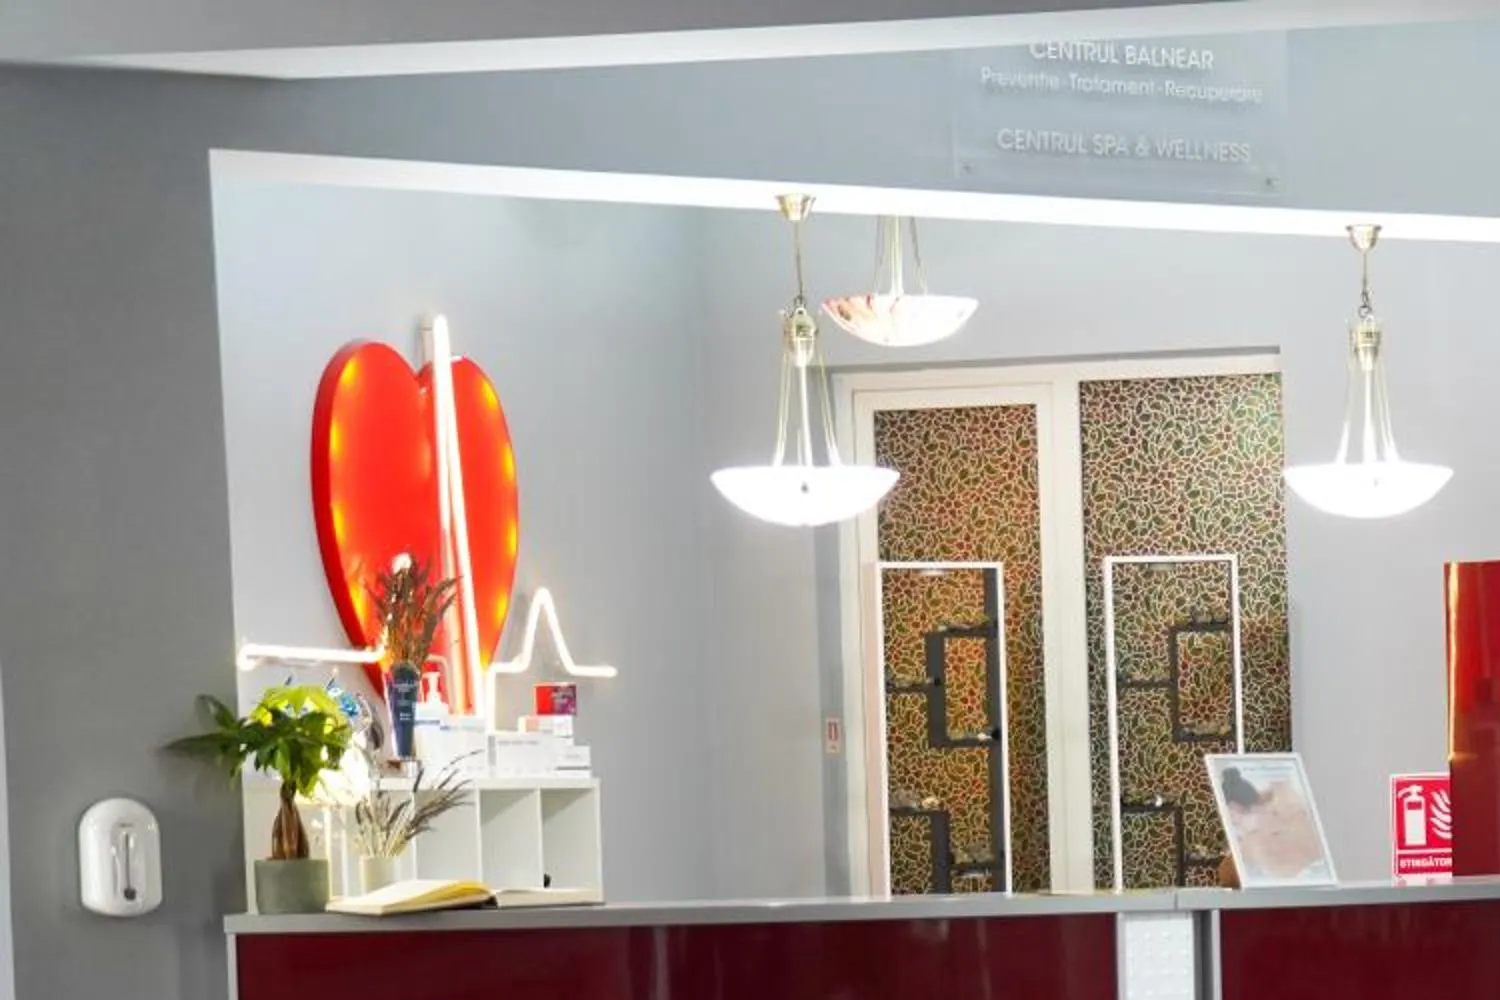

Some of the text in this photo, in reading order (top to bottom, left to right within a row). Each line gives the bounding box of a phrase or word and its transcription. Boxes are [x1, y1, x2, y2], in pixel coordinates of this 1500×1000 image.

[1029, 40, 1215, 70] CENTRUL BALNEAR
[997, 127, 1252, 164] CENTRUL SPA & WELLNESS
